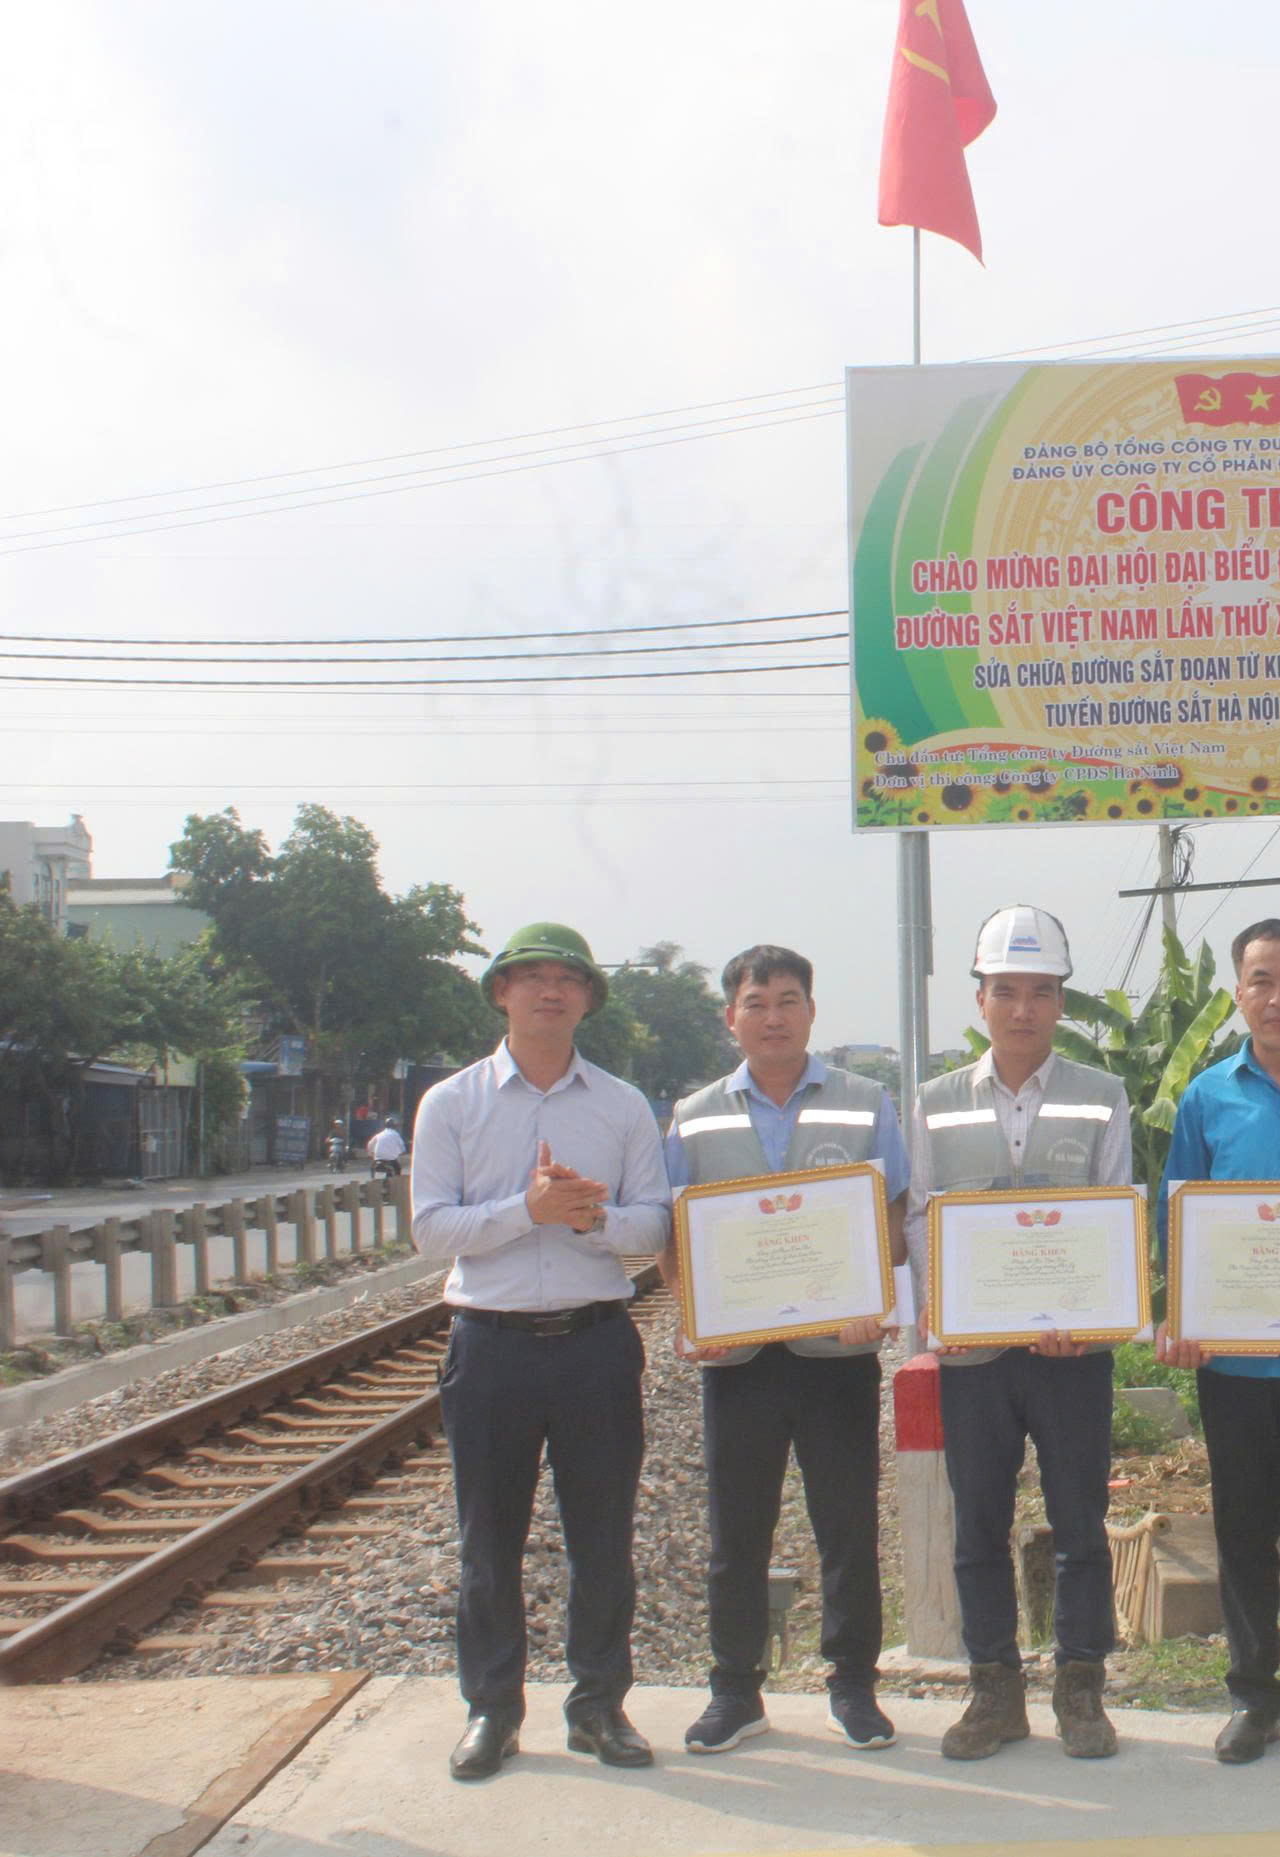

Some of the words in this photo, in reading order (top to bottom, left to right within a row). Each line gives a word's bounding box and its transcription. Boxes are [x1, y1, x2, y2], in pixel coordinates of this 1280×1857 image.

[1012, 462, 1065, 480] ĐẢNG
[1072, 460, 1094, 478] ỦY
[1101, 457, 1157, 476] CÔNG
[1163, 461, 1182, 474] TY
[1188, 453, 1216, 473] CỔ
[1024, 441, 1077, 459] ĐẢNG
[1083, 441, 1108, 460] BỘ
[1114, 436, 1165, 455] TỔNG
[1171, 437, 1228, 454] CÔNG
[1233, 439, 1252, 452] TY
[1097, 483, 1226, 533] CÔNG
[912, 554, 978, 593] CHÀO
[986, 551, 1060, 590] MỪNG
[1067, 555, 1108, 593] ĐẠI
[1116, 546, 1157, 591] HỘI
[1165, 551, 1206, 590] ĐẠI
[1215, 537, 1271, 581] BIỂU
[896, 608, 980, 648] ĐƯỜNG
[988, 600, 1034, 645] SẮT
[1041, 605, 1093, 649] VIỆT
[1101, 608, 1157, 640] NAM
[1166, 596, 1213, 639] LẦN
[1221, 598, 1270, 636] THỨ
[974, 656, 1011, 688] SỬA
[1017, 659, 1066, 687] CHỮA
[1071, 656, 1134, 685] ĐƯỜNG
[1141, 650, 1175, 682] SẮT
[1180, 656, 1230, 686] ĐOẠN
[1236, 652, 1260, 679] TỪ
[1045, 695, 1103, 728] TUYẾN
[1108, 696, 1172, 726] ĐƯỜNG
[1177, 690, 1212, 723] SẮT
[1218, 694, 1242, 721] HÀ
[1248, 692, 1280, 726] NỘI
[1155, 742, 1184, 758] Việt
[1190, 742, 1226, 754] Nam
[1139, 764, 1179, 778] Ninh
